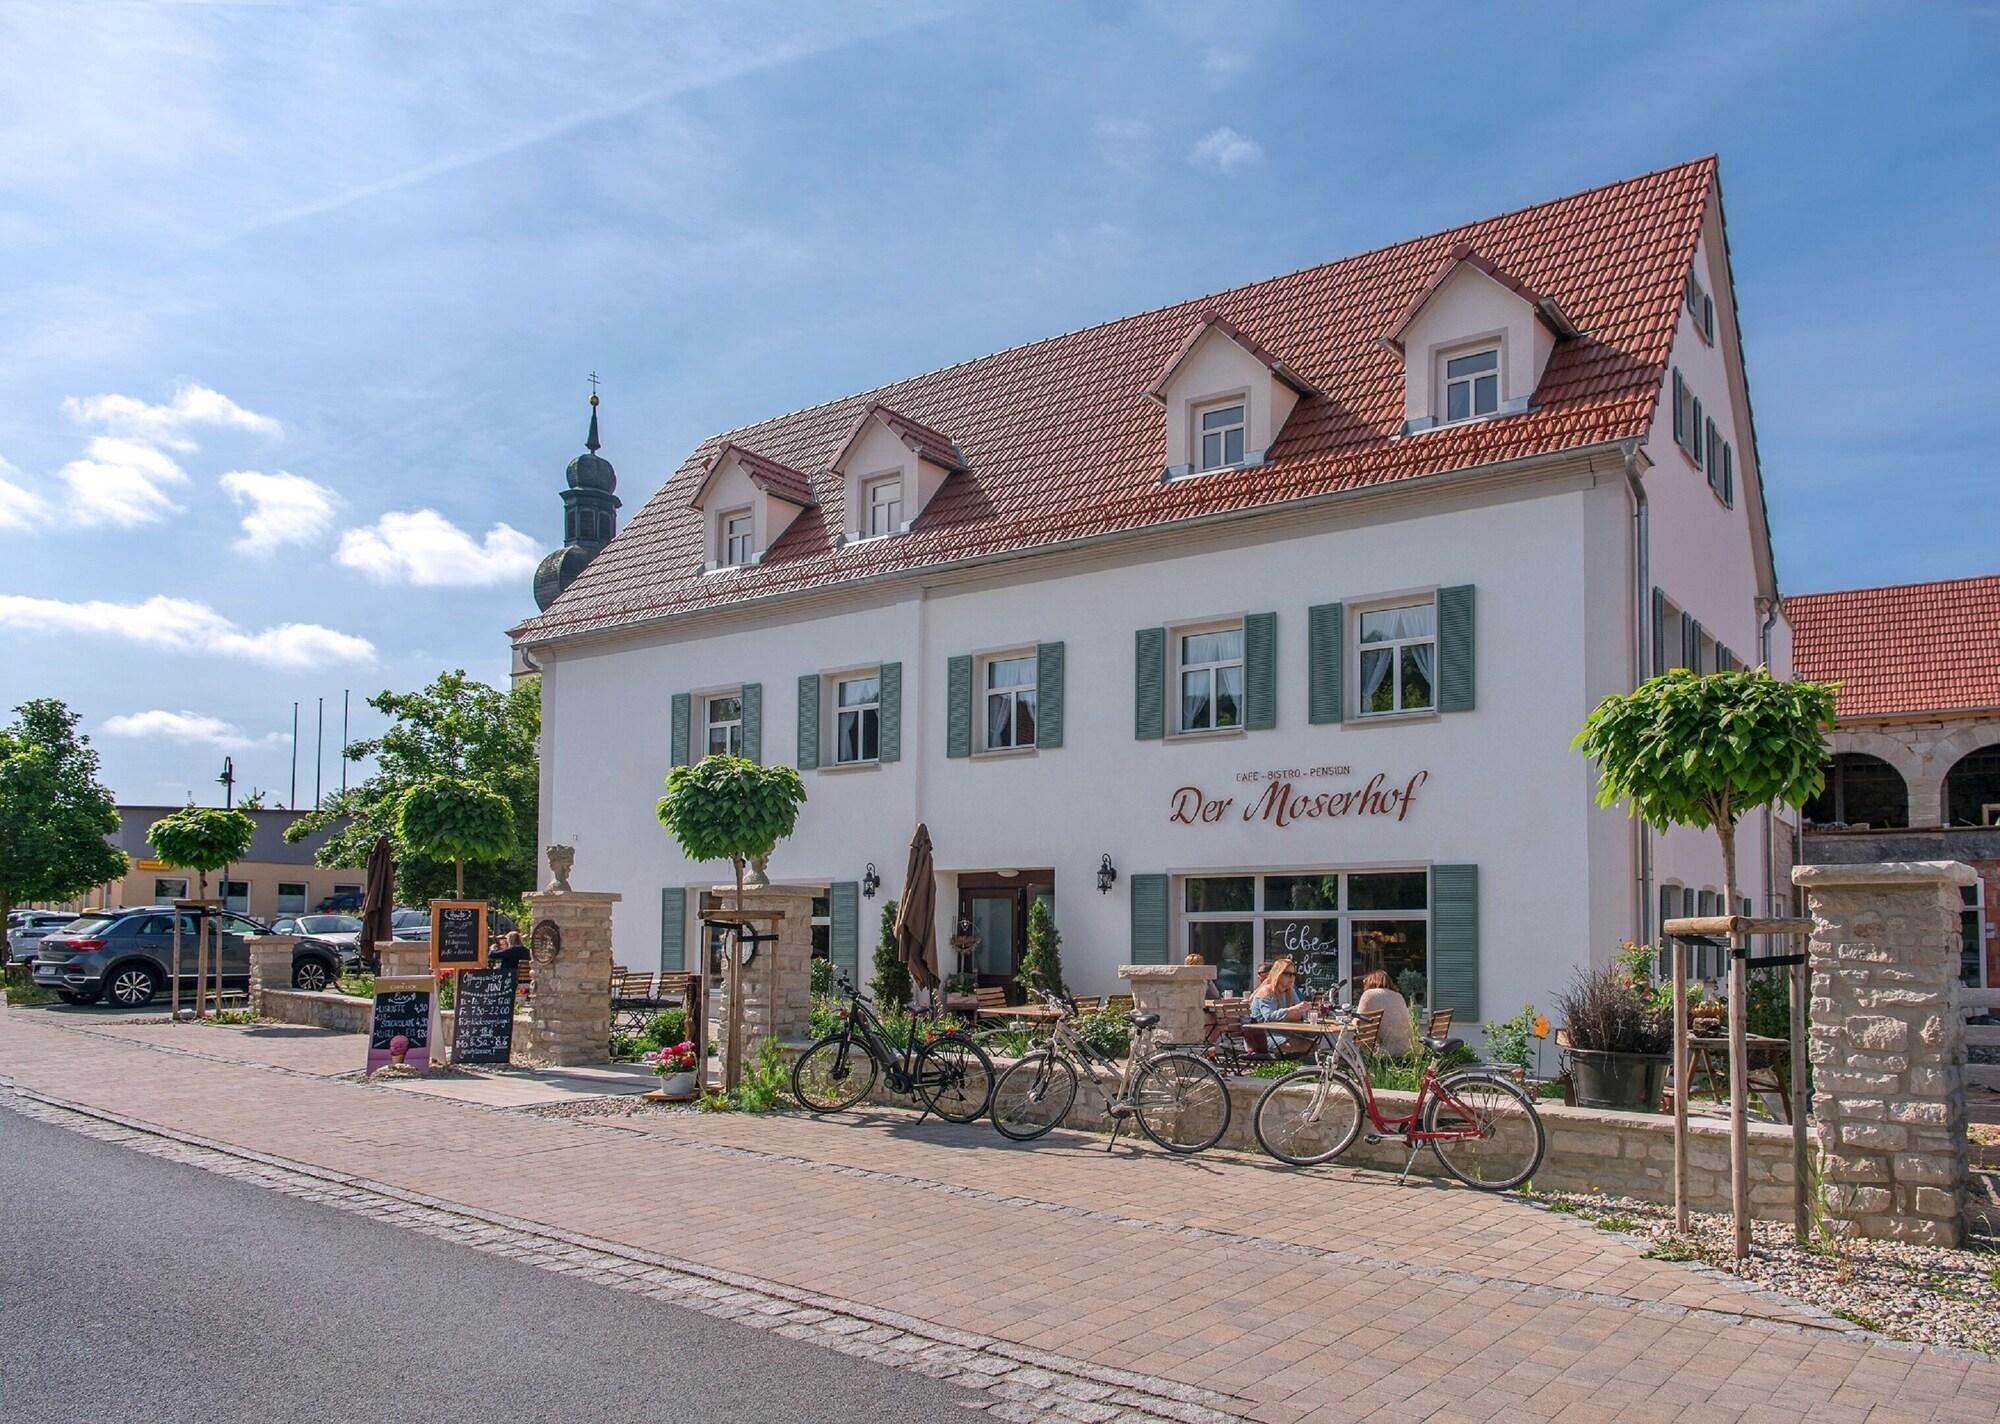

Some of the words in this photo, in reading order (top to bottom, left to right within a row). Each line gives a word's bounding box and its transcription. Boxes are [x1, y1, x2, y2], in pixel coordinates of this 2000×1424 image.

[1267, 769, 1301, 781] BISTRO
[1309, 766, 1350, 777] PENSION
[1170, 786, 1233, 824] Der
[1242, 770, 1429, 828] Moserhof
[484, 983, 502, 993] JUNI
